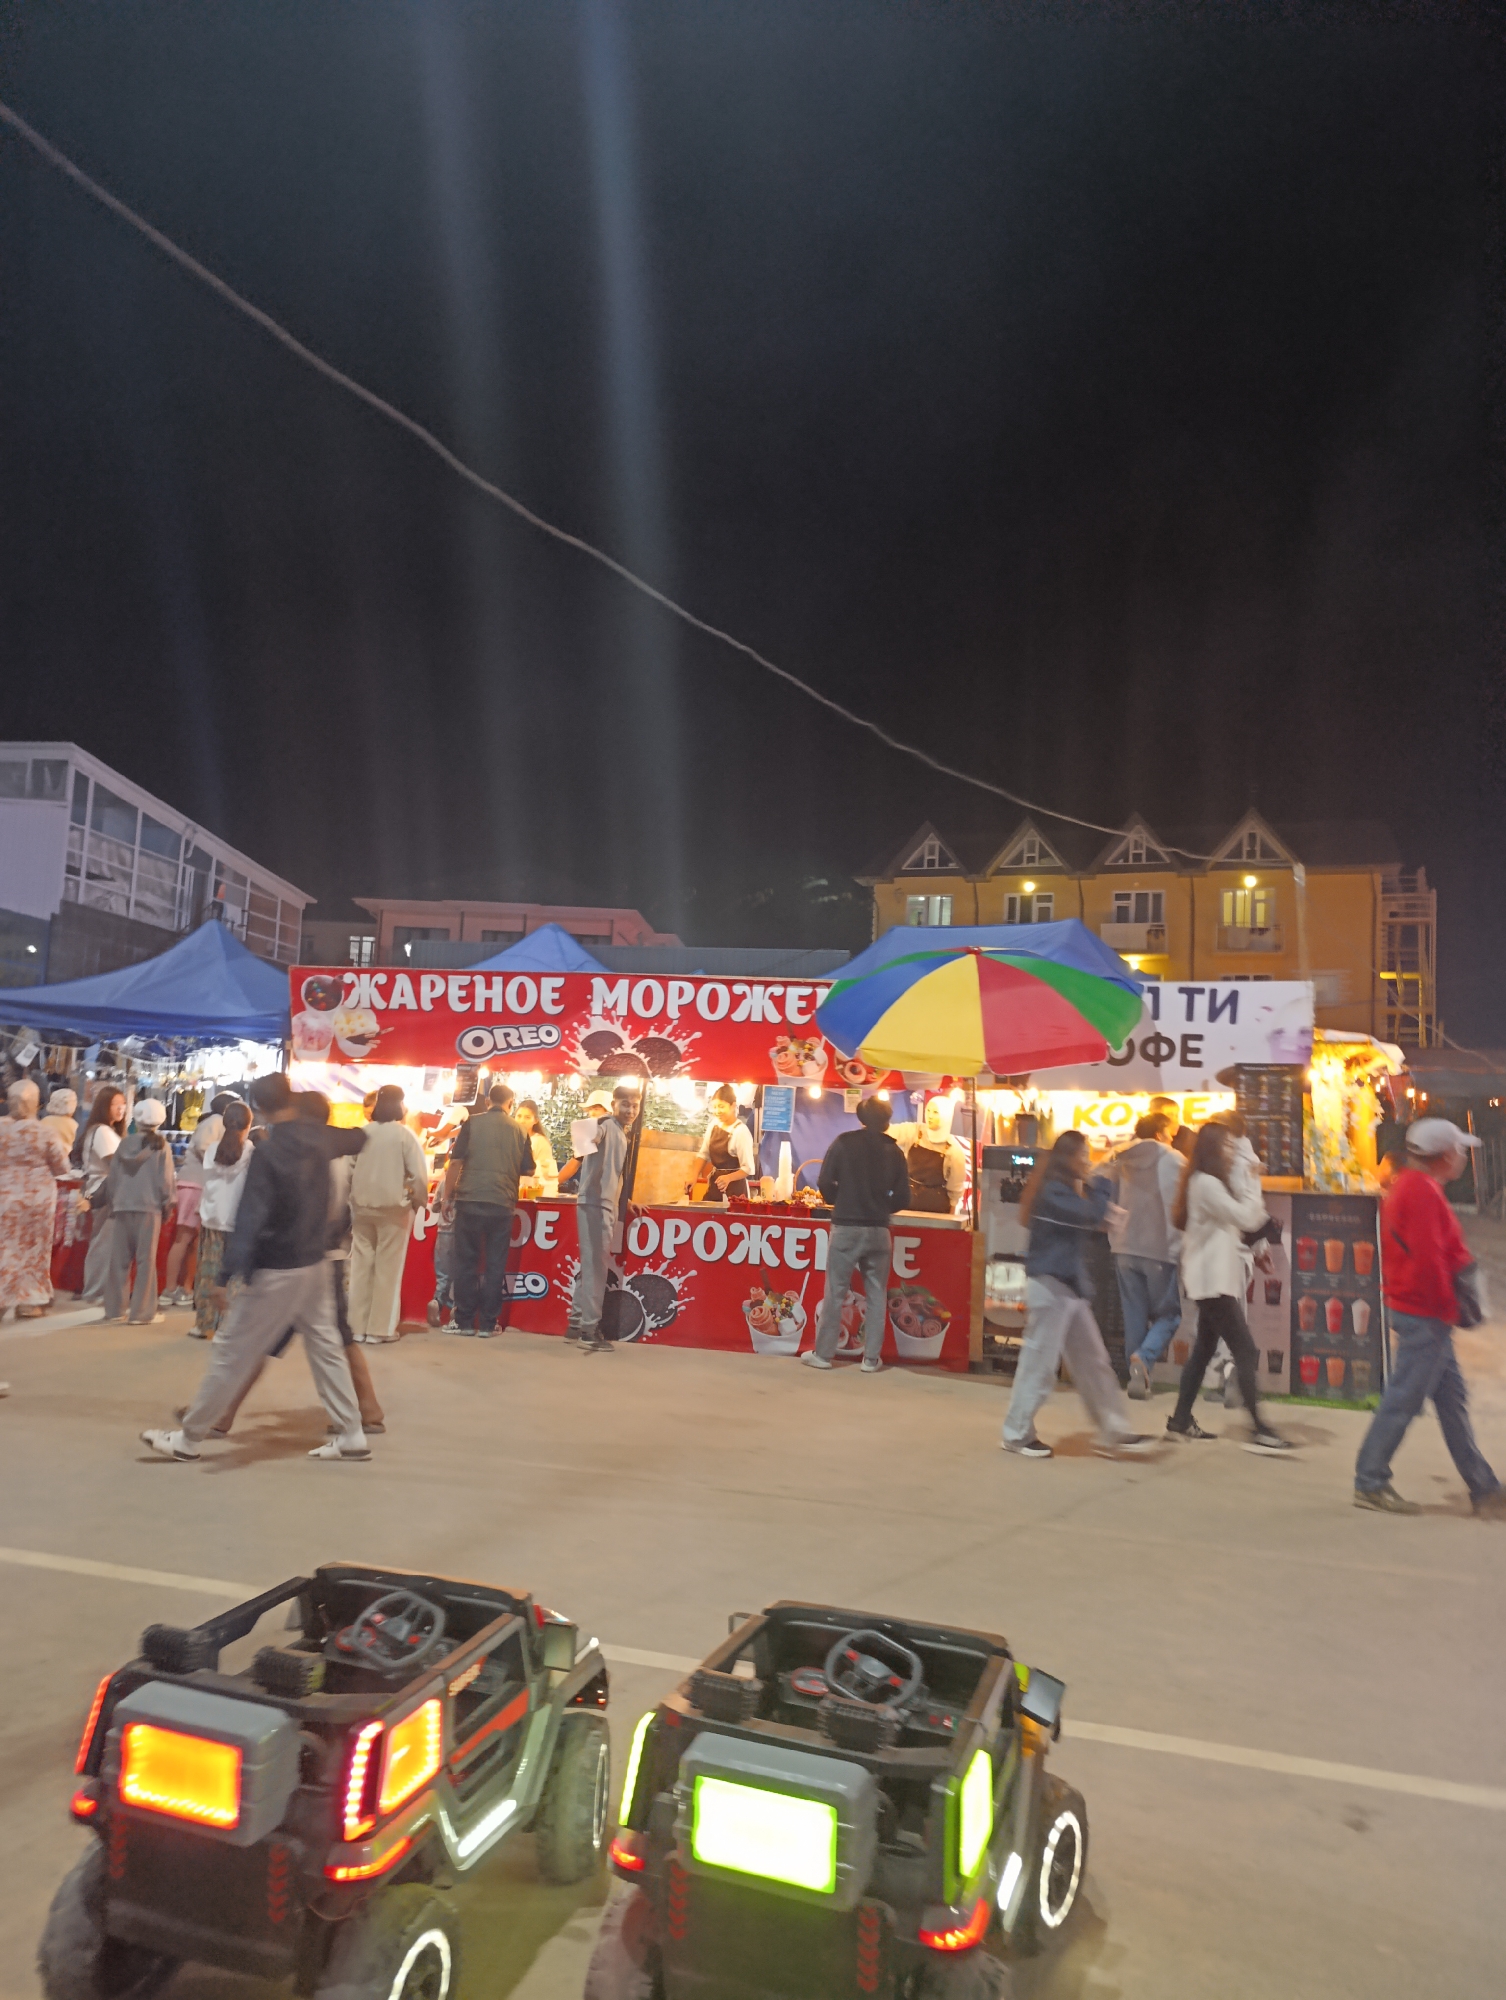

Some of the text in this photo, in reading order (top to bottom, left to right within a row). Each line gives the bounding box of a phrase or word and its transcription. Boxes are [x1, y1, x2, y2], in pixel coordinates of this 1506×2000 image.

[343, 972, 566, 1015] ЖАРЕНОЕ
[1178, 986, 1239, 1025] ТИ
[459, 1025, 560, 1058] OREO
[1091, 1032, 1204, 1068] ОФЕ
[1072, 1097, 1210, 1129] КОЕ
